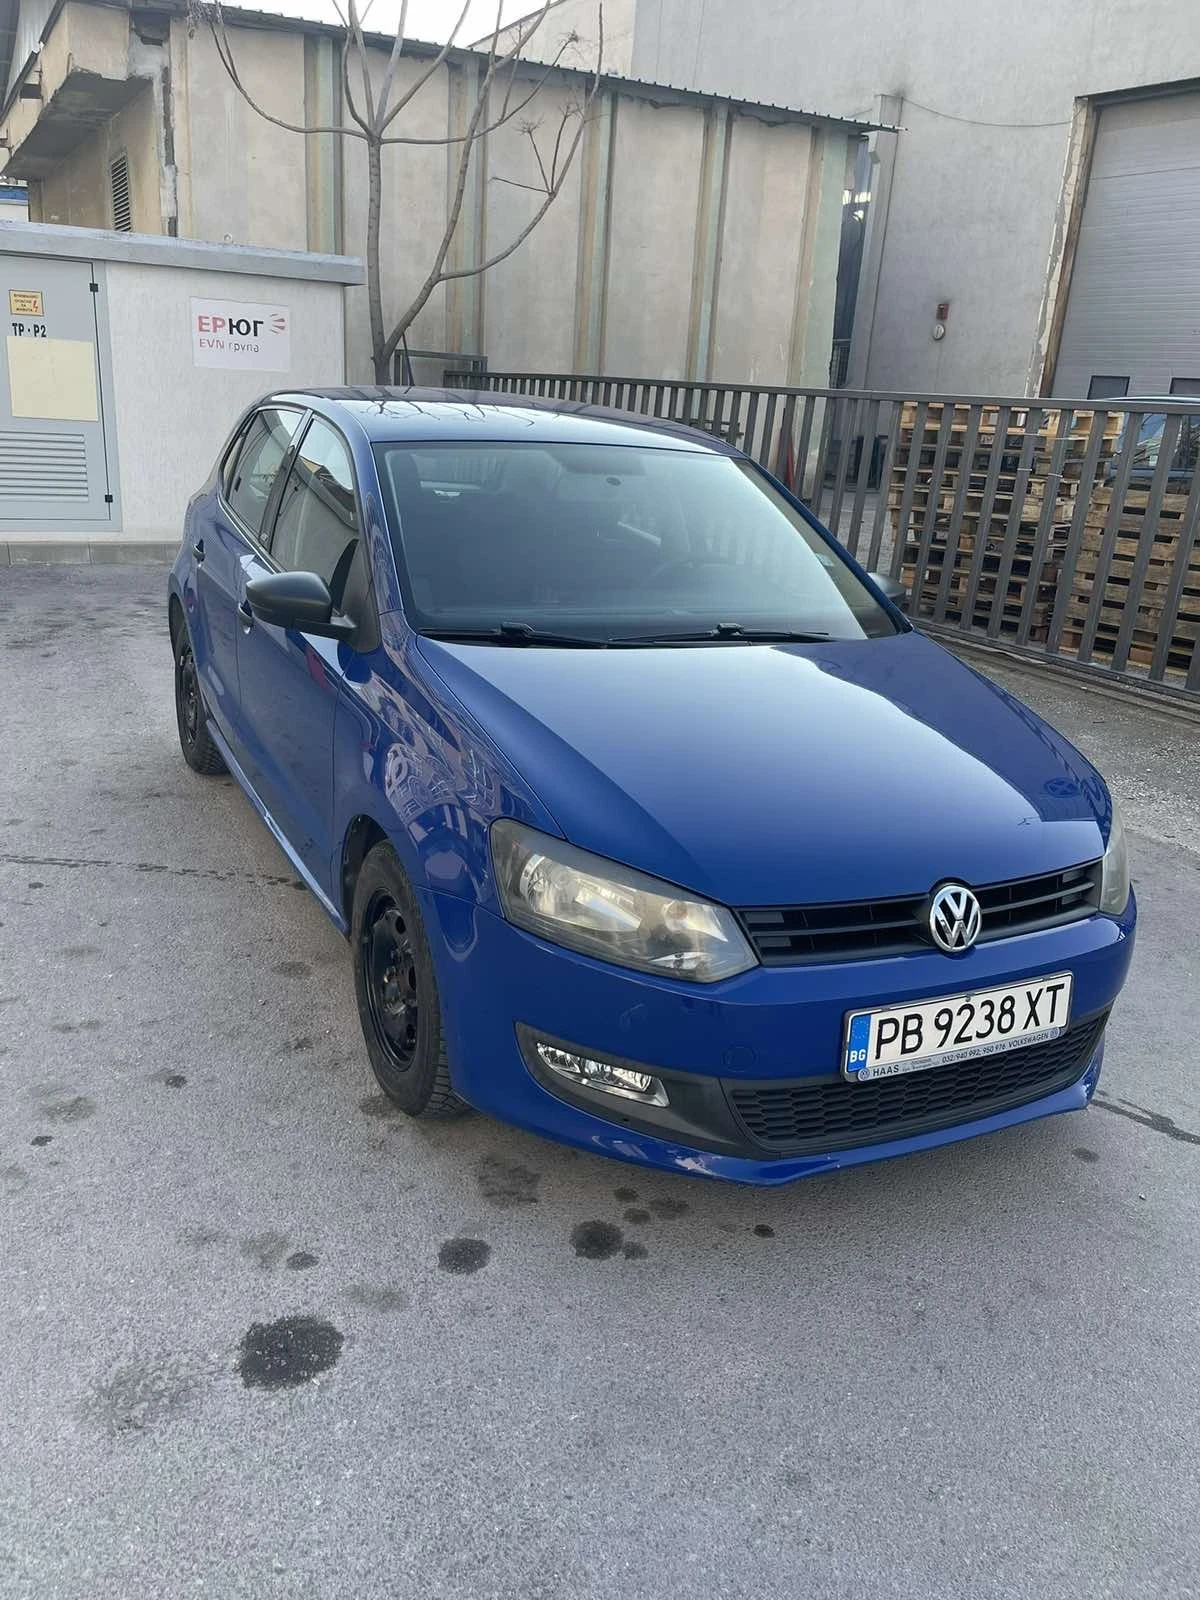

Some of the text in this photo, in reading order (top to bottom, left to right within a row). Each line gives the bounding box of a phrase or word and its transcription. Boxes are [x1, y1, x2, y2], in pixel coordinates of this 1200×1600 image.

[199, 339, 224, 349] EVN
[875, 983, 1065, 1060] PB 9238 XT
[850, 1049, 866, 1064] BG
[872, 1064, 899, 1078] HAAS
[1008, 1033, 1049, 1048] VOLKSWAGEN
